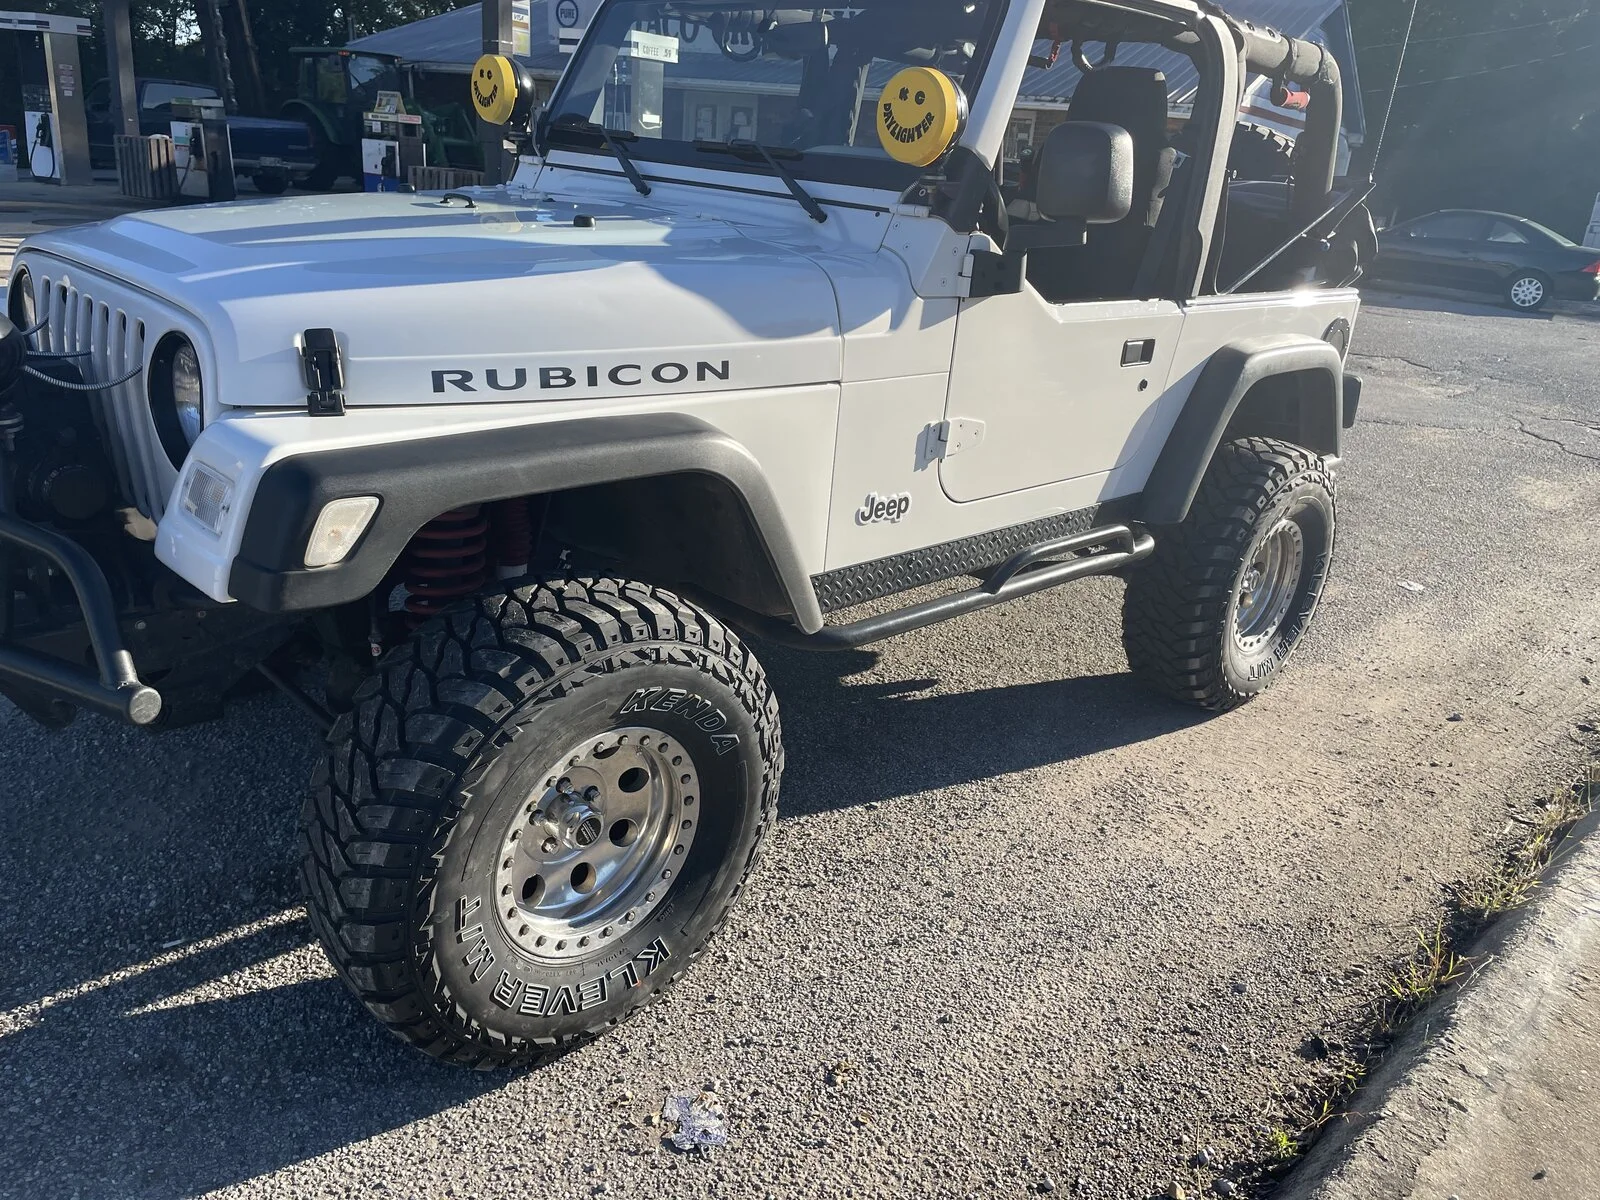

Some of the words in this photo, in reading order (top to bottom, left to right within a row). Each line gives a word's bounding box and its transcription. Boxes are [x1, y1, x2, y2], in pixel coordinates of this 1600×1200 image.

[513, 13, 524, 21] VISA
[560, 8, 575, 19] PURE
[642, 45, 659, 56] COFFEE
[473, 80, 498, 108] DAYLIGHTER
[883, 102, 935, 144] DAYLIGHTER
[431, 360, 730, 393] RUBICON
[857, 494, 910, 524] Jeep
[618, 686, 740, 756] KENDA
[454, 895, 497, 984] M/T
[489, 935, 672, 1018] KLEVER
